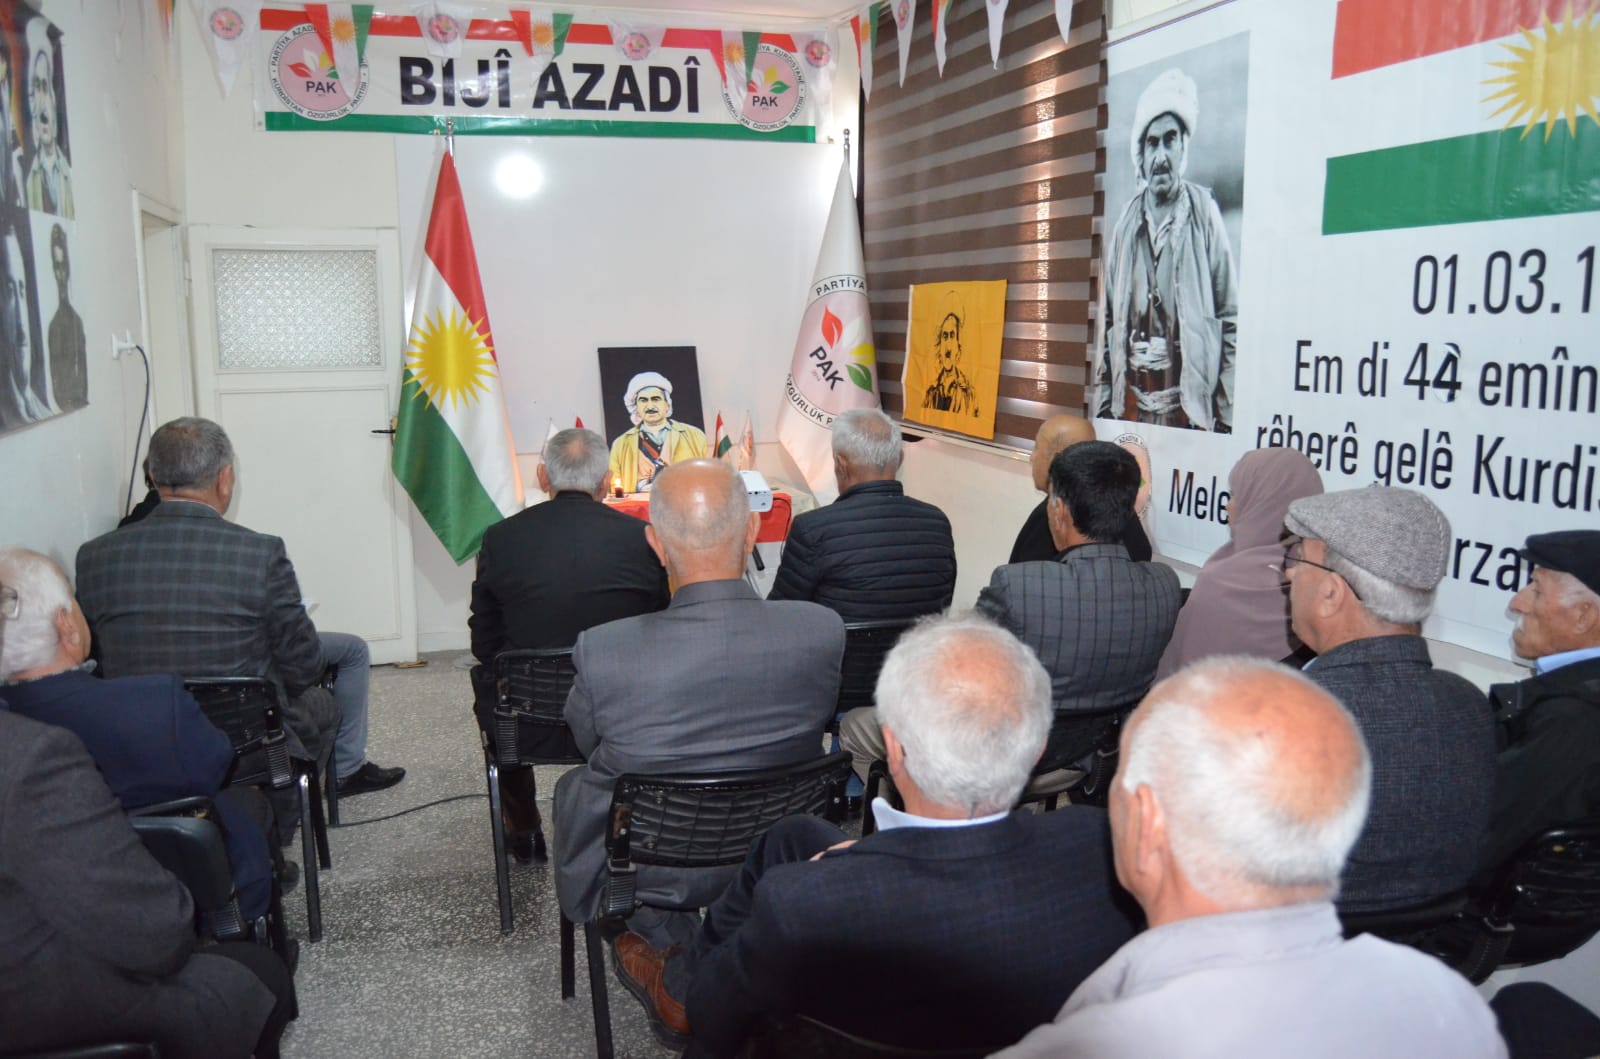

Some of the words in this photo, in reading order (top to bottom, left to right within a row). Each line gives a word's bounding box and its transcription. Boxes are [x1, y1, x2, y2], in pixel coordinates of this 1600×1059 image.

[306, 81, 336, 94] PAK
[400, 48, 512, 108] BIJÎ
[532, 56, 701, 113] AZADÎ
[752, 96, 778, 107] PAK
[809, 346, 844, 391] PAK
[1294, 340, 1343, 394] Em
[1357, 341, 1389, 398] di
[1403, 342, 1462, 402] 44
[1478, 346, 1598, 414] emîn
[1472, 434, 1600, 512] Kurdi
[1169, 468, 1231, 525] Mele
[1444, 538, 1534, 593] rza
